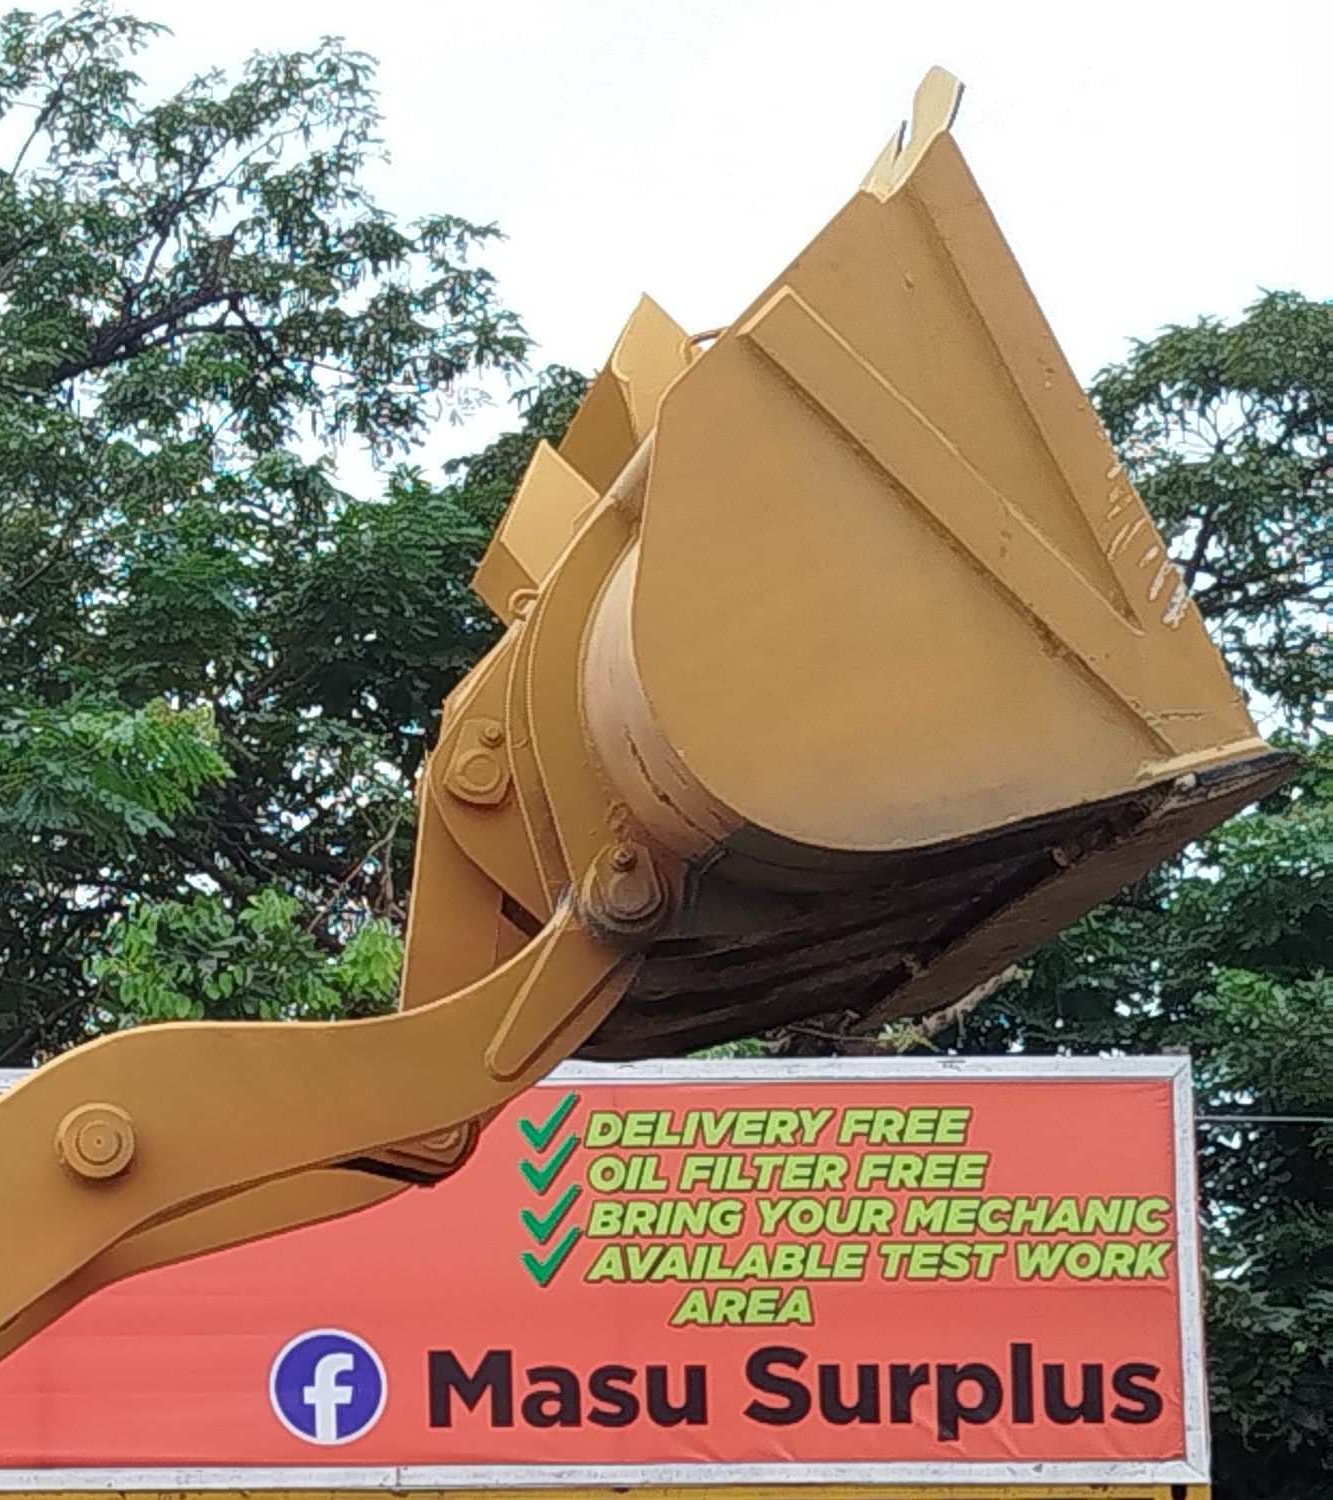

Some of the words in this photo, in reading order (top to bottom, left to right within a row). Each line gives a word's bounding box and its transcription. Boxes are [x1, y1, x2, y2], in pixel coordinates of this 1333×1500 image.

[585, 1108, 833, 1146] DELIVERY
[838, 1107, 971, 1145] FREE
[588, 1153, 668, 1192] OIL
[679, 1153, 848, 1191] FILTER
[857, 1152, 989, 1190] FREE
[587, 1199, 744, 1237] BRING
[756, 1198, 894, 1236] YOUR
[902, 1196, 1171, 1234] MECHANIC
[585, 1243, 868, 1281] AVAILABLE
[880, 1242, 1005, 1280] TEST
[1016, 1242, 1172, 1280] WORK
[669, 1288, 814, 1325] AREA
[426, 1348, 709, 1429] Masu
[743, 1342, 1162, 1441] Surplus
